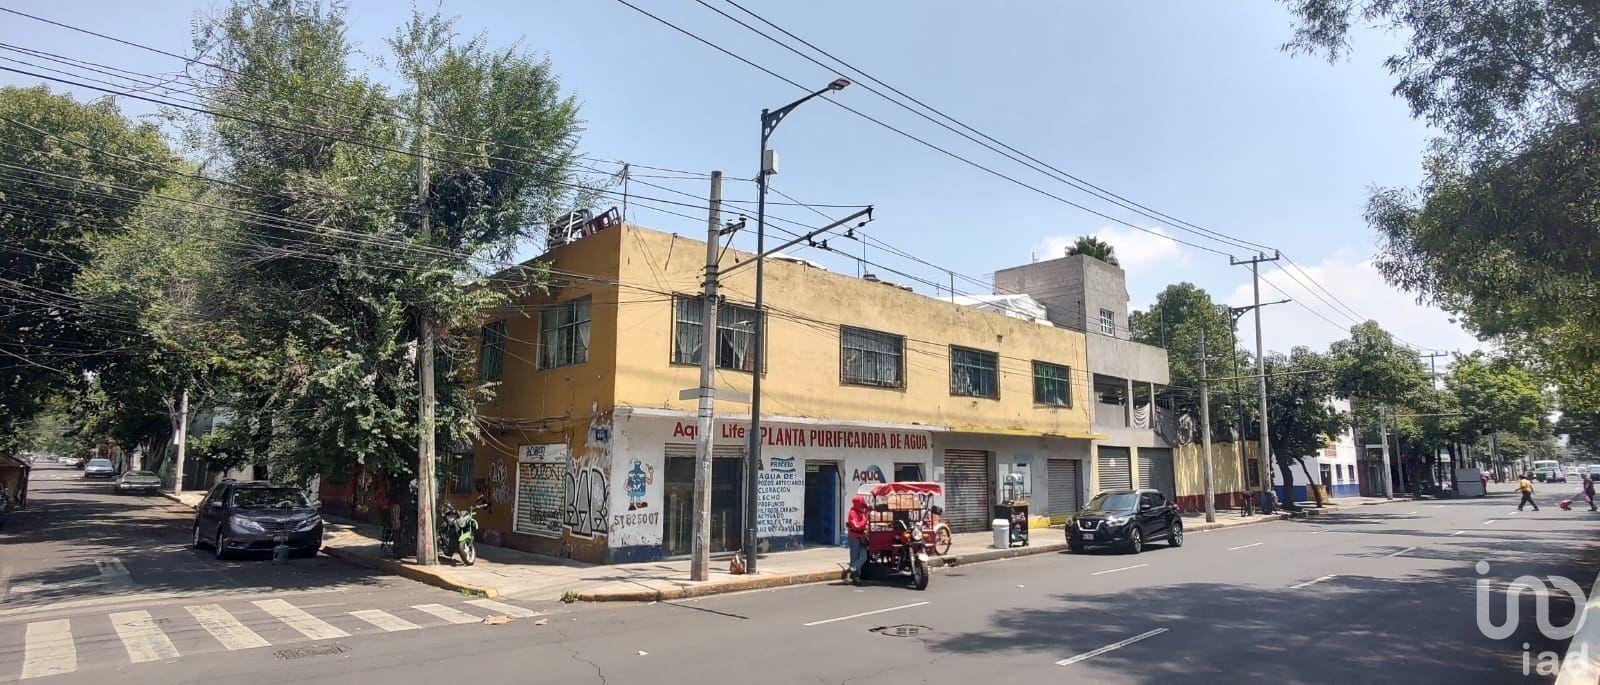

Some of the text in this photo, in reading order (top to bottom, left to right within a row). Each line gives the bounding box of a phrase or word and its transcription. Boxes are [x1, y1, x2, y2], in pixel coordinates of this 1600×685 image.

[722, 423, 745, 439] Life
[760, 427, 928, 450] PLANTA PURIFICADORA DE AGUA
[852, 468, 880, 481] Aqua
